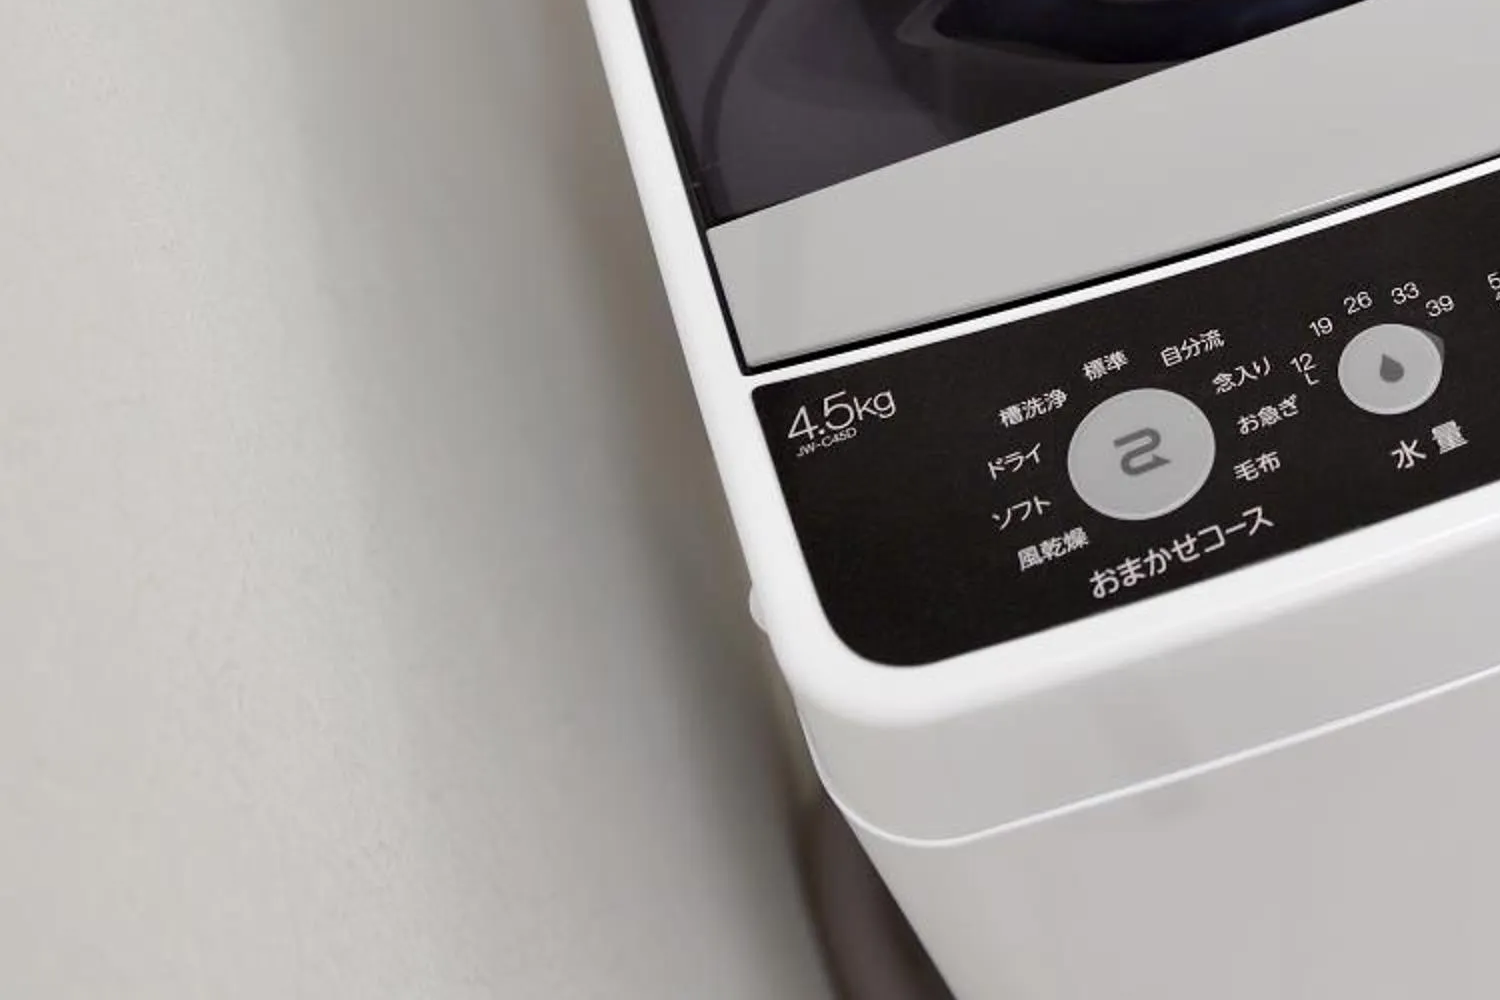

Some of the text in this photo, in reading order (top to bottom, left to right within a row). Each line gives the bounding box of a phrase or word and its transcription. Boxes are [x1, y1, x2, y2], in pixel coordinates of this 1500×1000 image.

[1289, 281, 1455, 374] 12 19 26 33 39
[1083, 350, 1128, 382] 標準
[1161, 330, 1225, 367] 自分流
[1212, 356, 1271, 394] 念入り
[788, 389, 897, 440] 4.5kg
[999, 388, 1068, 428] 槽洗浄
[1237, 393, 1299, 435] お急ぎ
[987, 443, 1041, 480] ドライ
[1233, 451, 1281, 481] 毛布
[993, 496, 1051, 530] ソフト
[1017, 527, 1089, 571] 風乾燥
[1089, 505, 1276, 600] おまかせコース
